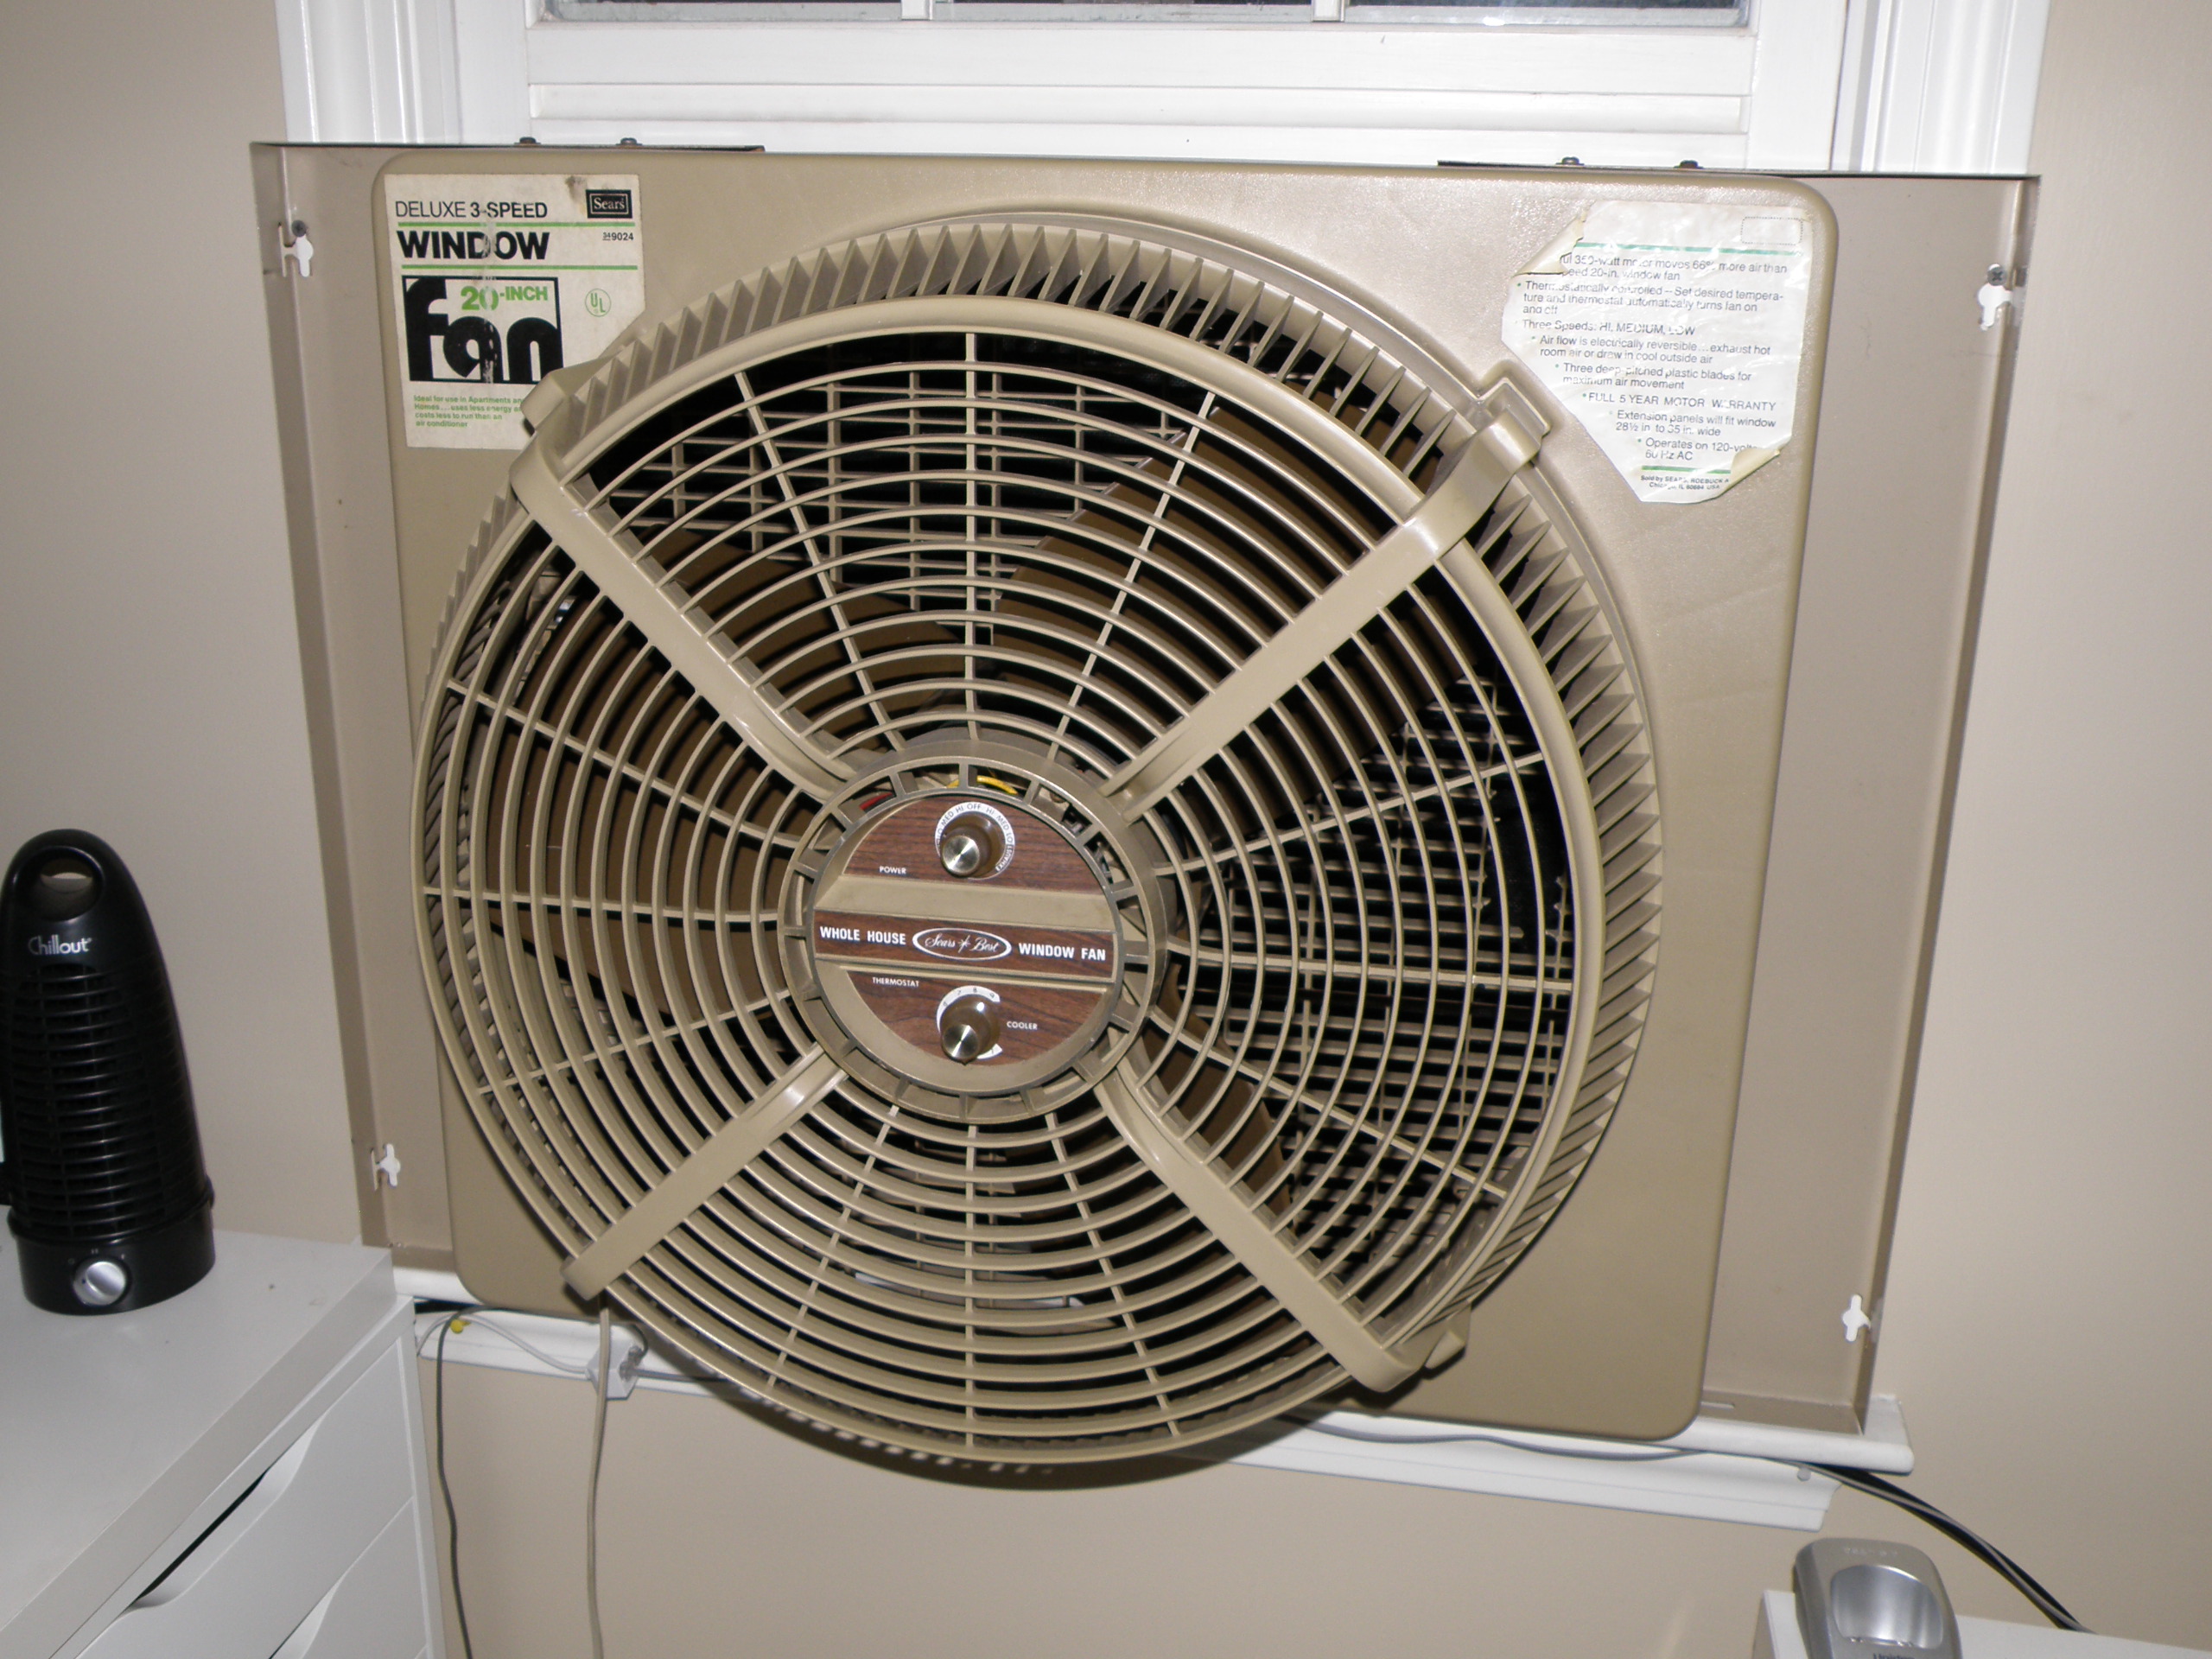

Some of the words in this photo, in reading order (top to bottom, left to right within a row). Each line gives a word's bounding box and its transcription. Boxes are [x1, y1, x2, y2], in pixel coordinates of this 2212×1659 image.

[396, 201, 465, 217] DELUXE
[470, 201, 548, 218] 3-SPEED
[594, 197, 626, 209] Sears
[397, 231, 550, 259] WINDOW
[1656, 260, 1690, 270] moves
[1719, 262, 1746, 271] more
[1749, 263, 1761, 271] air
[1764, 264, 1787, 273] than
[1622, 270, 1662, 280] window
[1664, 271, 1681, 281] fan
[461, 286, 549, 311] 20-INCH
[1675, 286, 1692, 296] Set
[1694, 288, 1733, 298] desired
[1736, 289, 1783, 302] tempera-
[1522, 305, 1542, 315] and
[1523, 293, 1544, 302] ture
[1547, 294, 1566, 303] and
[1568, 294, 1623, 305] thermostat
[1696, 301, 1722, 310] turns
[1725, 302, 1742, 311] fan
[1745, 303, 1758, 312] on
[404, 277, 563, 384] fan
[1522, 319, 1552, 329] Three
[1540, 335, 1554, 345] Air
[1556, 336, 1577, 346] flow
[1580, 336, 1587, 346] is
[1590, 337, 1644, 350] electrically
[1754, 345, 1771, 355] hot
[1569, 348, 1582, 357] air
[1584, 349, 1595, 358] or
[1597, 349, 1622, 359] draw
[1624, 350, 1634, 359] in
[1636, 352, 1657, 361] cool
[1660, 353, 1698, 363] outside
[1700, 354, 1713, 364] air
[1564, 363, 1593, 372] Three
[1665, 368, 1698, 378] plastic
[1700, 369, 1735, 380] blades
[1738, 371, 1752, 381] for
[1615, 378, 1628, 387] air
[1630, 378, 1685, 390] movement
[1588, 392, 1615, 404] FULL
[1619, 394, 1626, 403] 5
[1629, 395, 1659, 405] YEAR
[1664, 396, 1705, 408] MOTOR
[1712, 398, 1777, 411] WRRANTY
[1618, 410, 1668, 422] Extension
[1669, 414, 1704, 424] panels
[1707, 415, 1723, 424] will
[1726, 415, 1735, 425] fit
[1737, 416, 1777, 428] window
[1656, 423, 1665, 433] to
[1668, 424, 1681, 434] 35
[1697, 426, 1721, 436] wide
[1645, 437, 1693, 449] Operates
[1695, 442, 1708, 450] on
[1676, 450, 1694, 461] AC
[880, 866, 906, 875] POWER
[820, 926, 860, 941] WHOLE
[867, 931, 906, 945] HOUSE
[925, 933, 957, 949] Sears
[971, 938, 1000, 953] Best
[29, 934, 90, 955] Chillout
[1019, 943, 1075, 959] WINDOW
[1081, 948, 1106, 961] FAN
[872, 976, 919, 988] THERMOSTAT
[1006, 1020, 1038, 1030] COOLER
